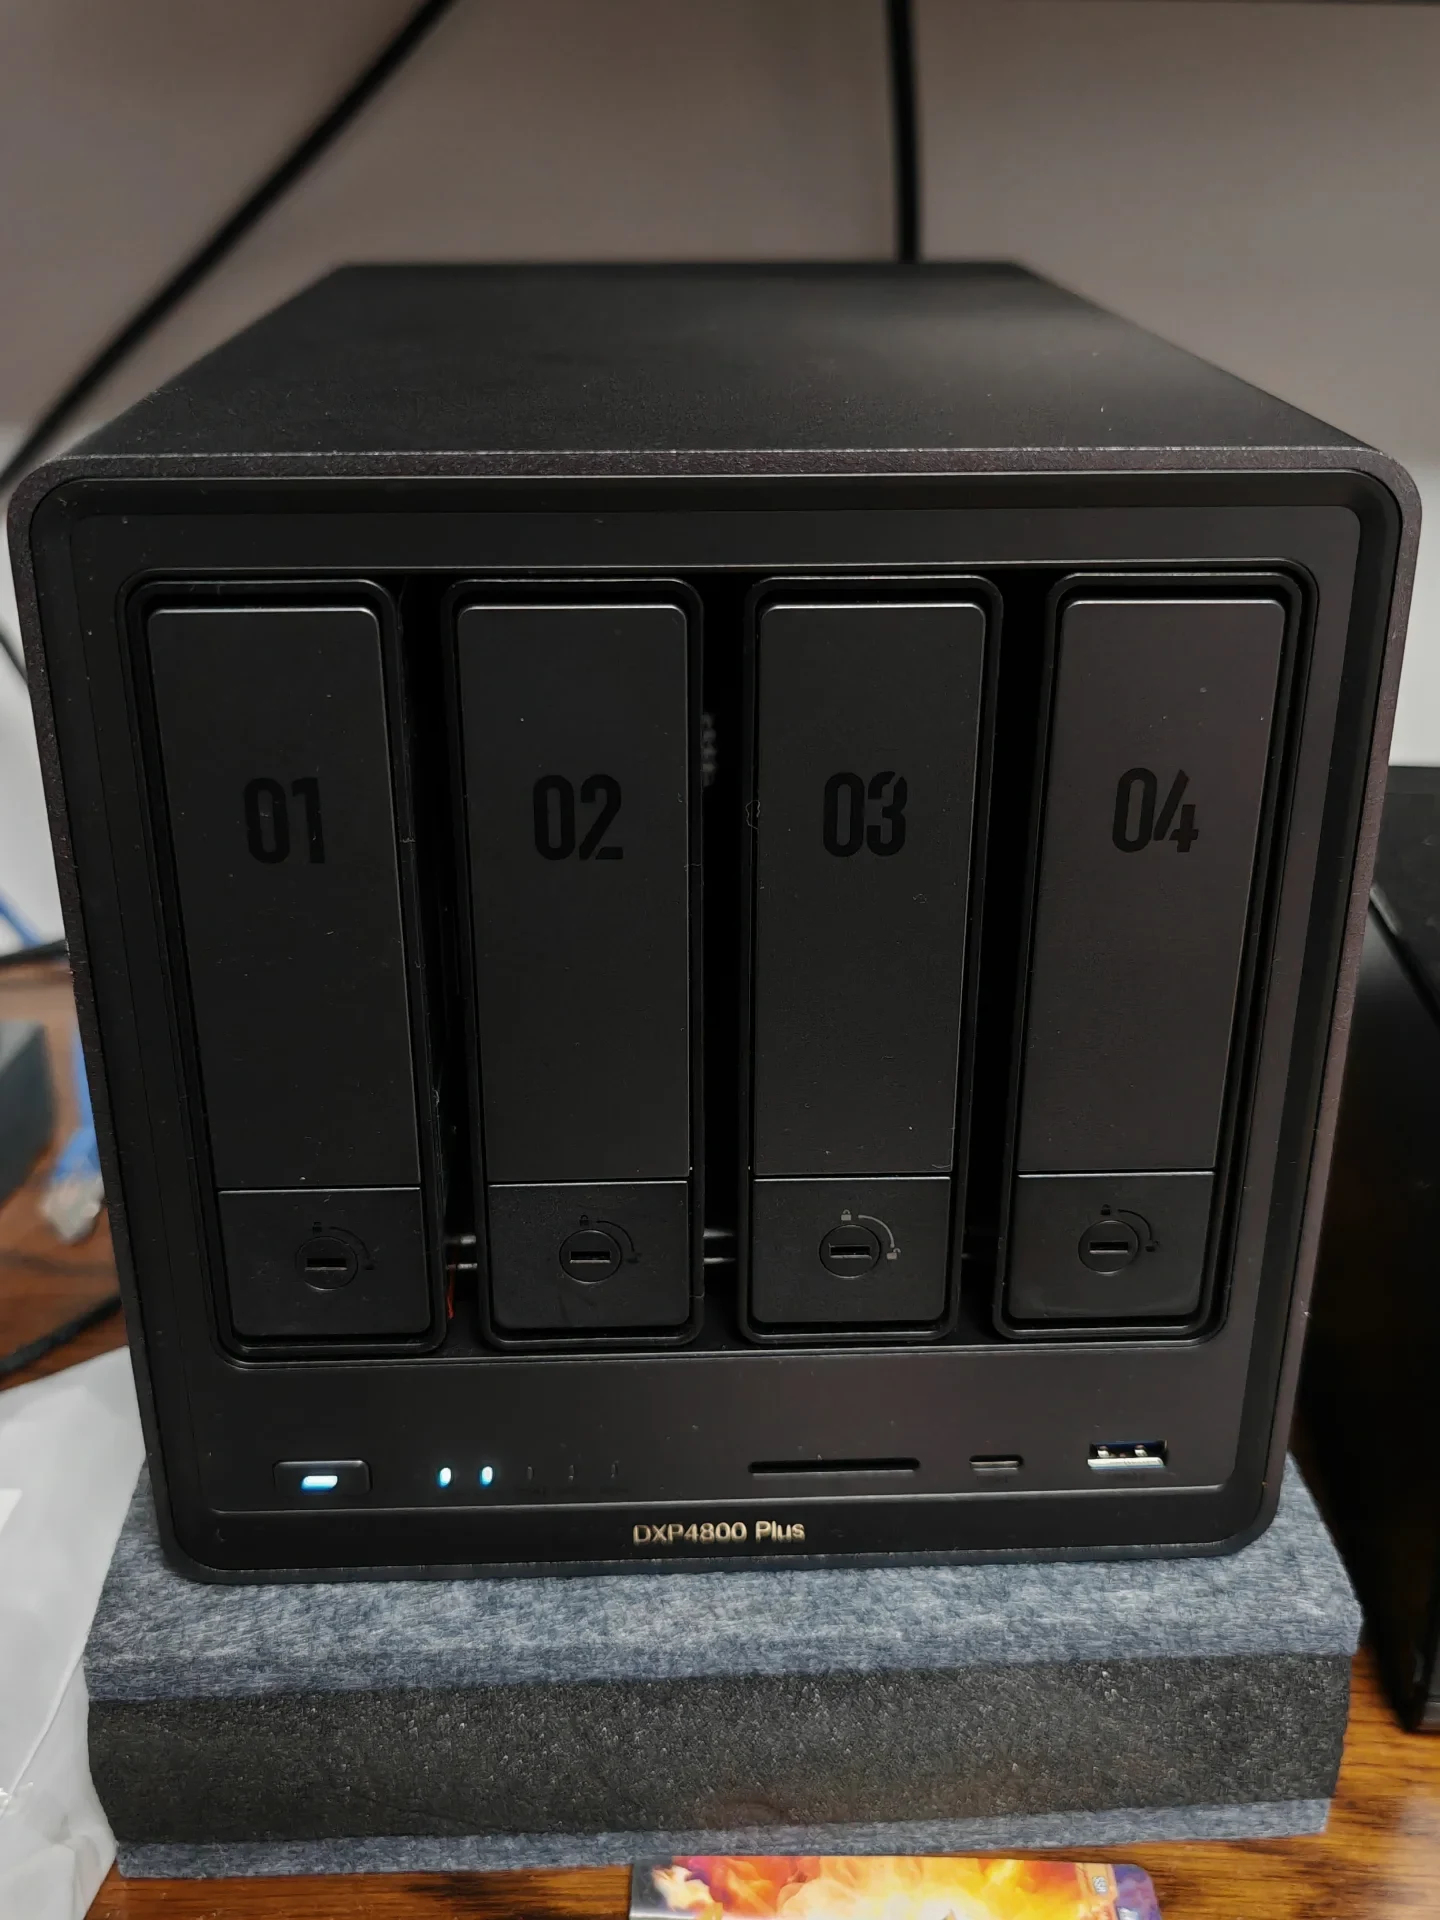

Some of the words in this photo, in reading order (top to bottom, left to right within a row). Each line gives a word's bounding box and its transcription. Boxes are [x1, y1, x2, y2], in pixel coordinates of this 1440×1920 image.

[244, 777, 325, 865] 01
[533, 773, 623, 860] 02
[823, 771, 908, 858] 03
[1112, 767, 1199, 854] 04
[633, 1522, 747, 1545] DXP4800
[755, 1521, 806, 1543] Plus
